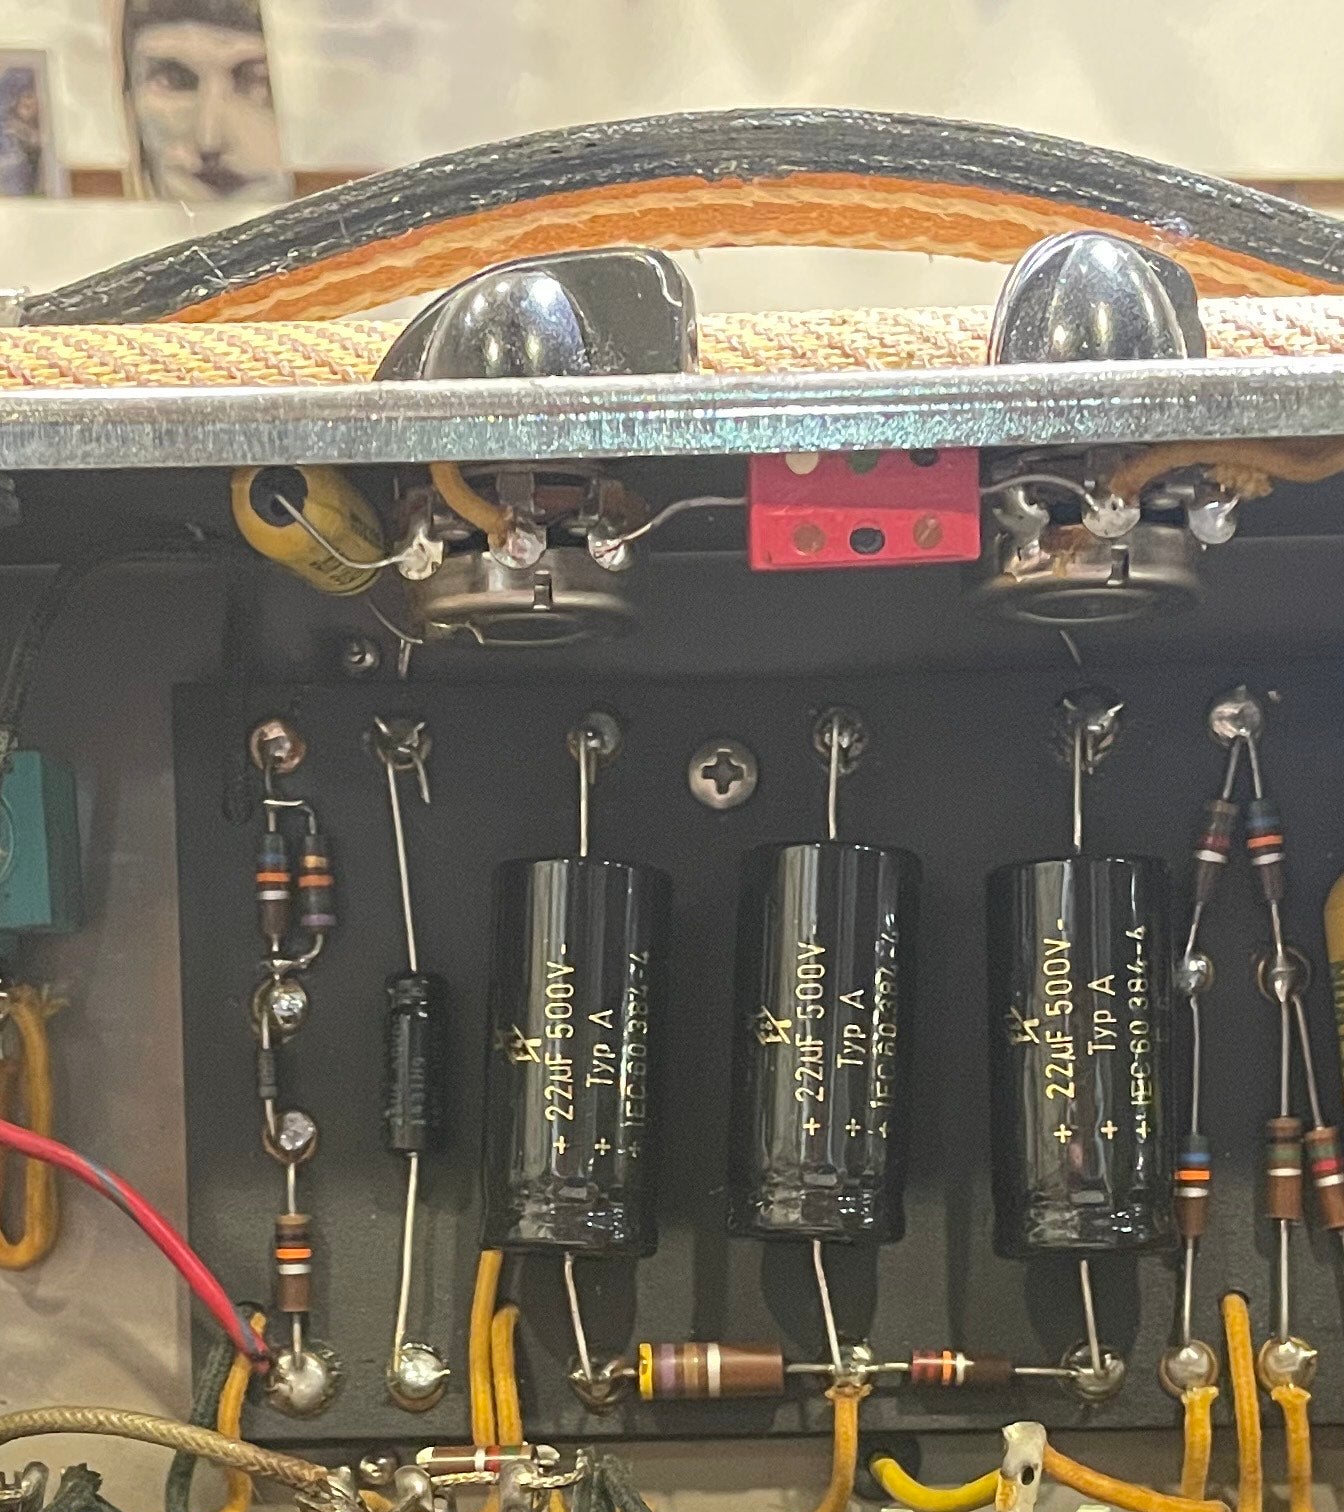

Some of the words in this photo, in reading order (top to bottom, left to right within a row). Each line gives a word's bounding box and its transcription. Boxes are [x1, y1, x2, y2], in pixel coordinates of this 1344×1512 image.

[839, 989, 865, 1009] A
[1088, 974, 1116, 996] A
[589, 1009, 613, 1028] A
[1088, 1010, 1117, 1055] Typ
[836, 1024, 866, 1068] Typ
[1129, 1020, 1150, 1053] 60
[586, 1043, 615, 1088] Typ
